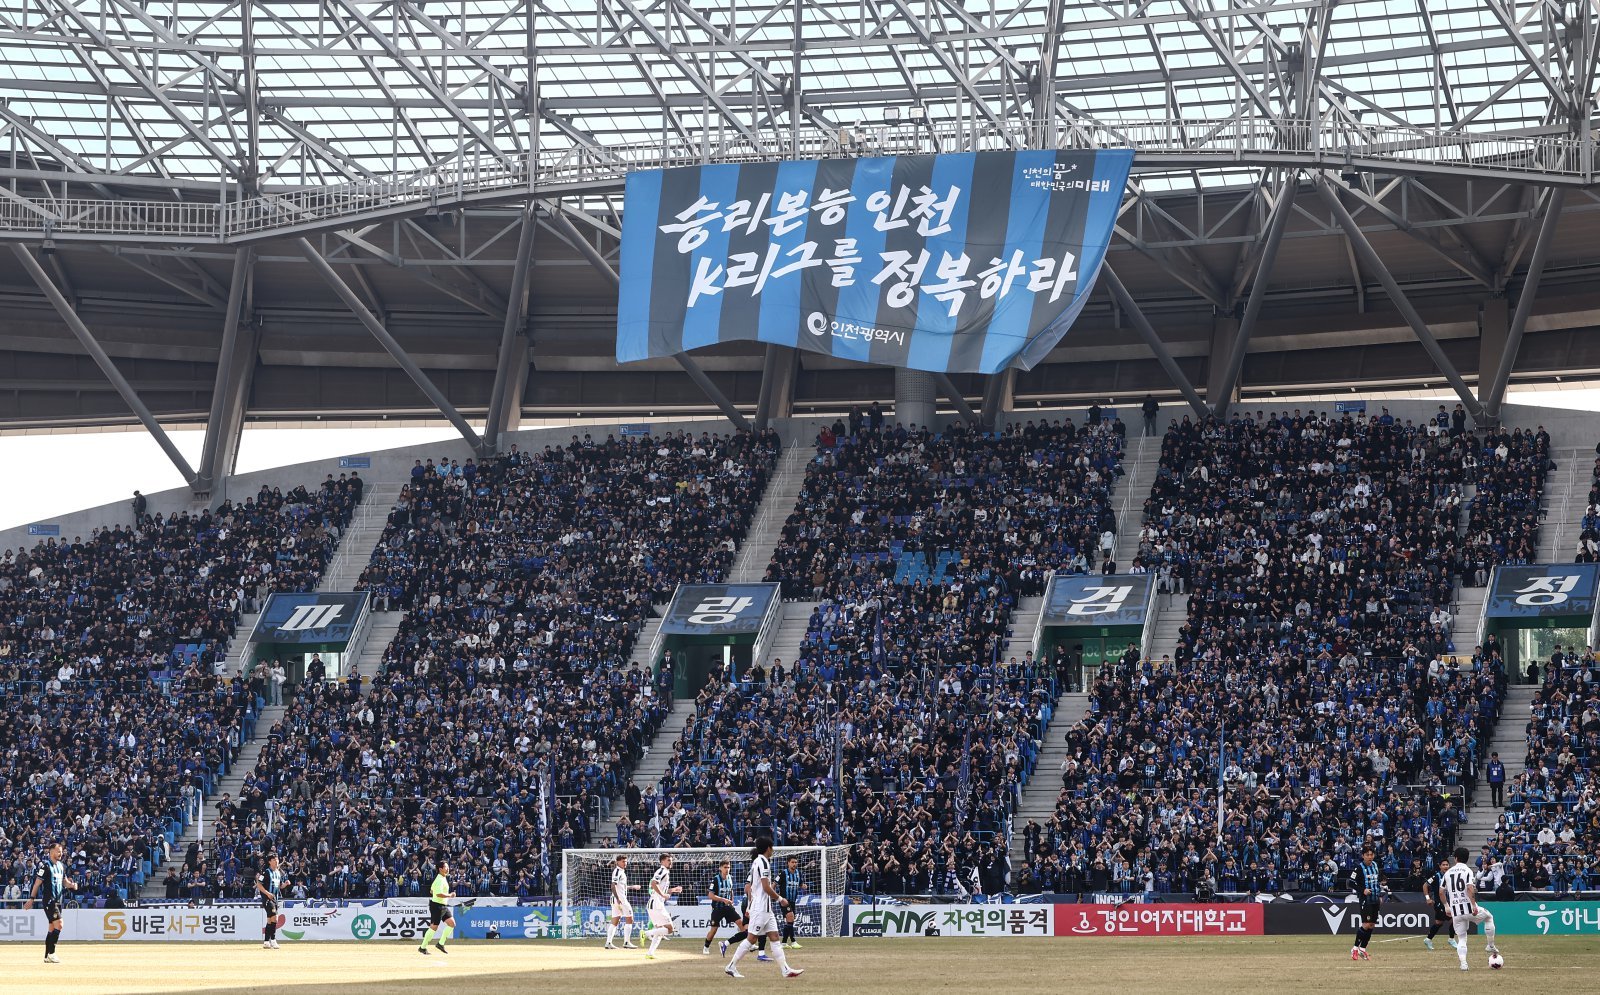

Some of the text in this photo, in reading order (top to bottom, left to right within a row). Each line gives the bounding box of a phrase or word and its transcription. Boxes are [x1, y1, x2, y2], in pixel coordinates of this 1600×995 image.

[659, 184, 961, 254] 승리본능 인천
[687, 238, 1077, 317] K리그를 정복하라
[830, 321, 905, 346] 인천광역시
[1067, 585, 1133, 615] 검
[1513, 574, 1582, 606] 정
[277, 603, 345, 631] 파
[688, 596, 754, 624] 랑
[1449, 872, 1466, 893] 16
[132, 915, 236, 934] 바로서구병원
[293, 916, 328, 926] 인천탁주
[354, 918, 372, 936] 생
[470, 919, 490, 928] 일상을
[1097, 909, 1246, 933] 경인여자대학교
